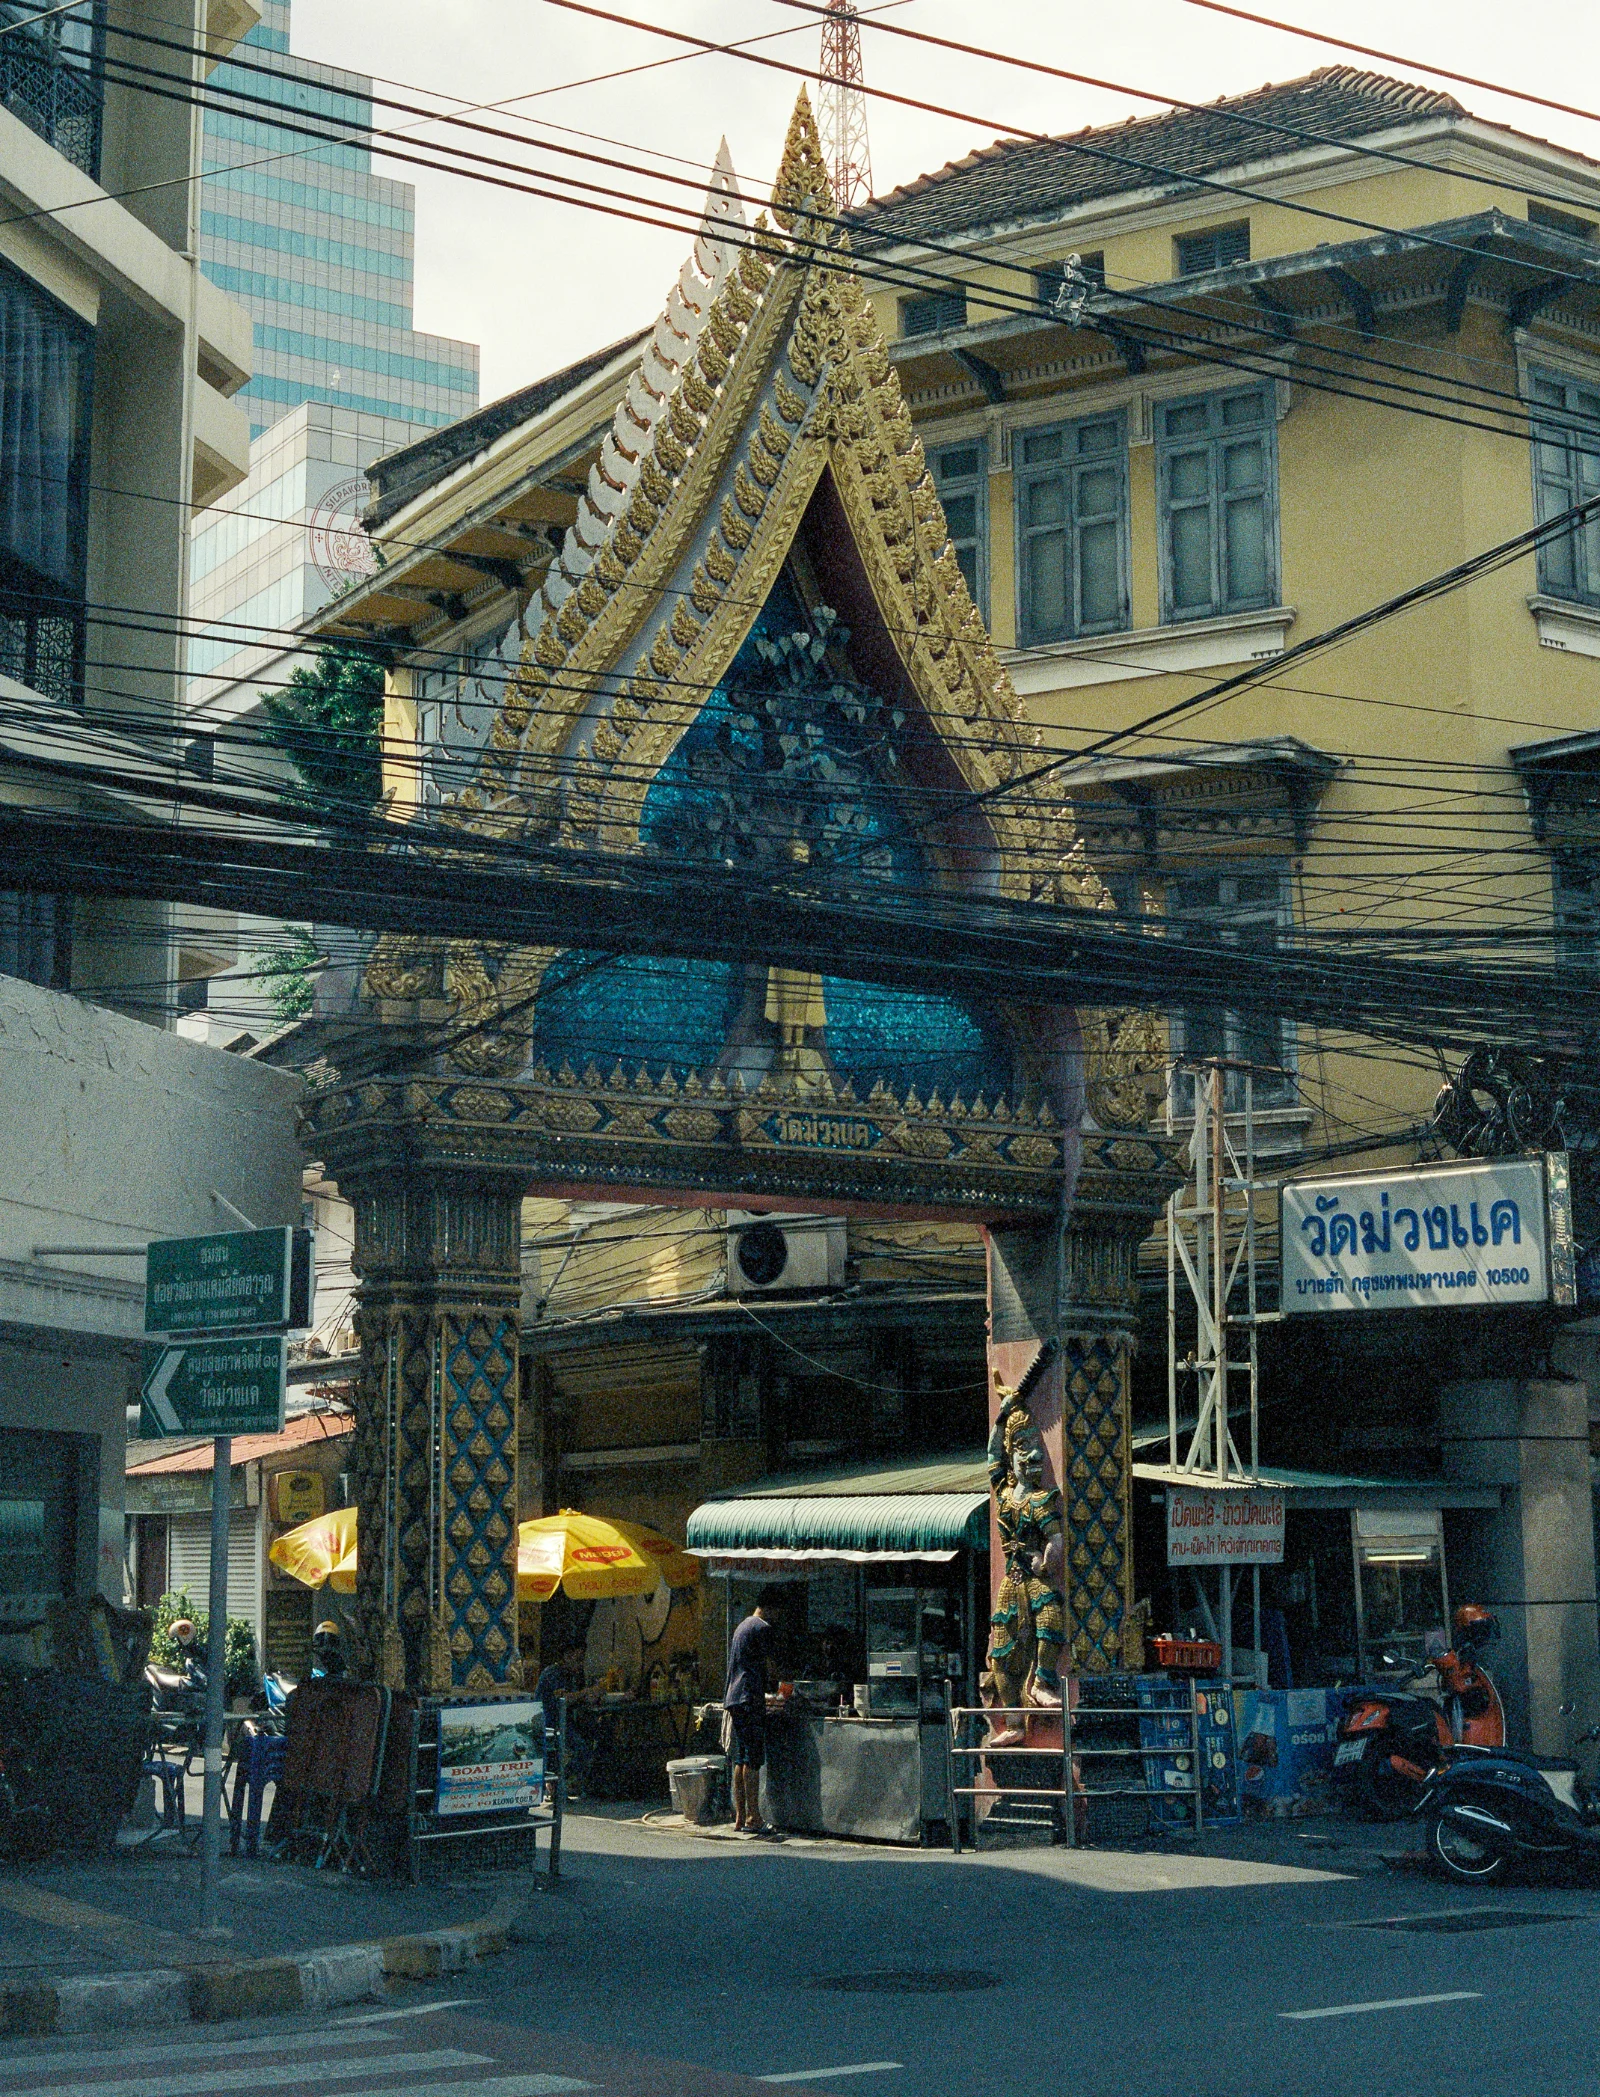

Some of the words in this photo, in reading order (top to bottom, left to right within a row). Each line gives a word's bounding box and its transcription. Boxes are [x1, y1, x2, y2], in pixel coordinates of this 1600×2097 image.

[1301, 1192, 1521, 1256] วัดม่วงแค
[1296, 1270, 1344, 1295] บางรัก
[1352, 1268, 1477, 1299] กรุงเทพมหานคร
[1486, 1267, 1530, 1286] 10500
[199, 1379, 260, 1408] วัดม่วงแค
[451, 1765, 492, 1776] BOAT
[499, 1761, 534, 1772] TRIP
[492, 1797, 515, 1806] KLONG
